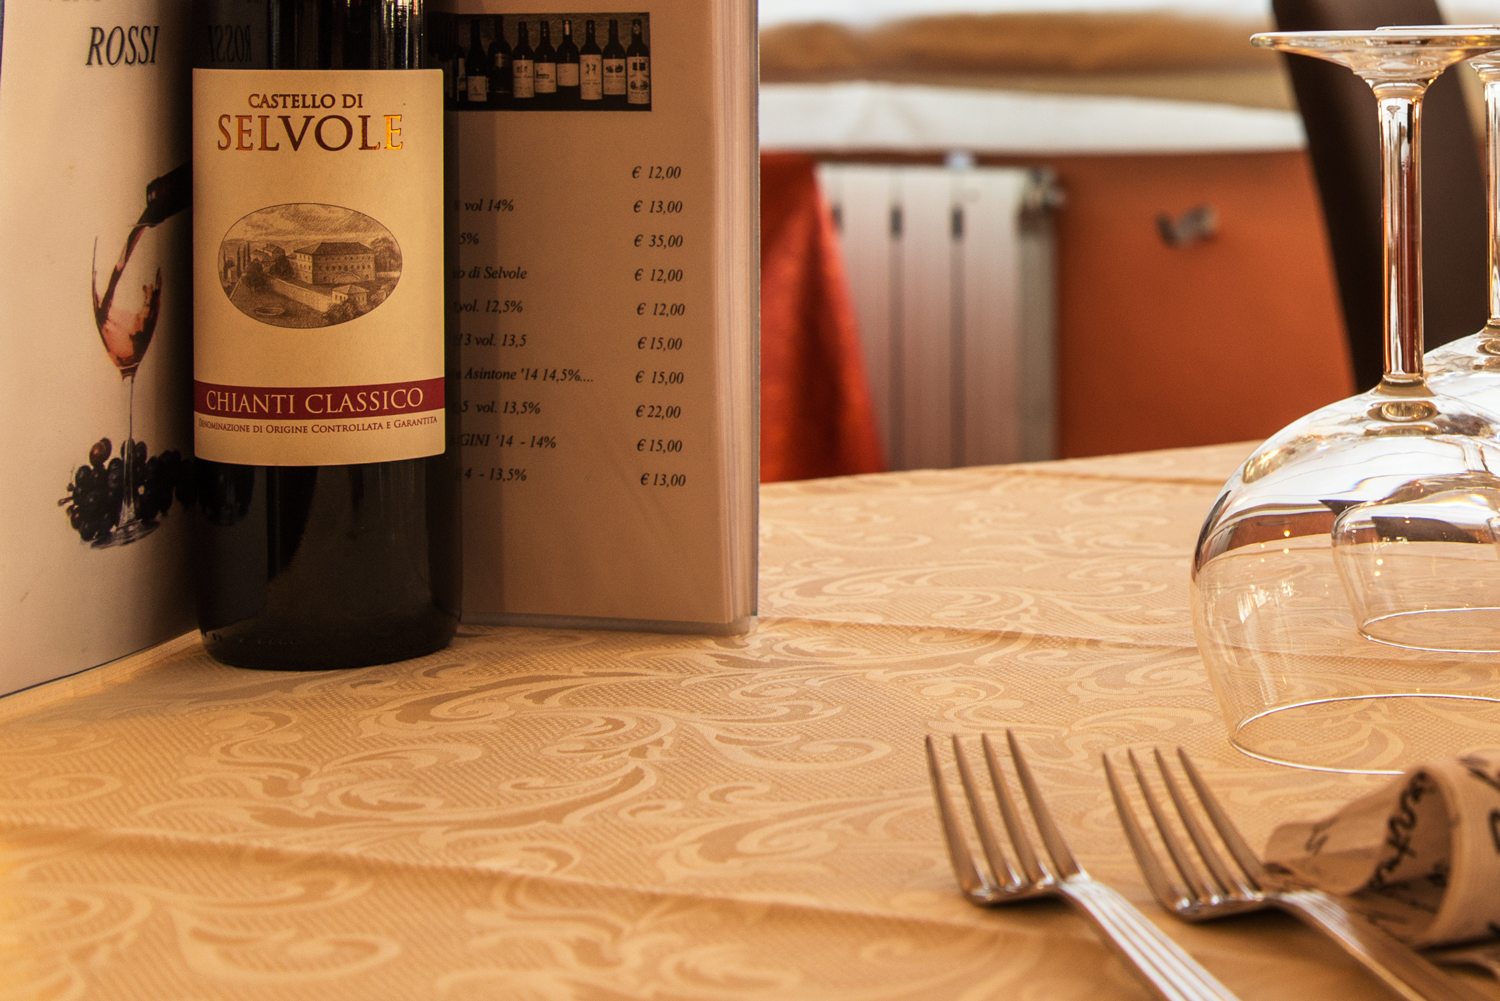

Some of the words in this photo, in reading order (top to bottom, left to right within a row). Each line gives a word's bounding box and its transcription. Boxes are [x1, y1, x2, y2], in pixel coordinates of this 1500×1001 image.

[86, 25, 160, 66] ROSSI
[248, 93, 336, 109] CASTELLO
[341, 93, 364, 109] DI
[217, 114, 403, 152] SELVOLE
[648, 166, 681, 181] 12,00
[465, 199, 483, 212] vol
[487, 199, 514, 212] 14%
[649, 200, 683, 215] 13,00
[459, 233, 480, 246] 5%
[648, 234, 683, 249] 35,00
[468, 266, 480, 279] di
[484, 266, 527, 280] Selvole
[650, 268, 683, 283] 12,00
[485, 300, 523, 315] 12,5%
[652, 302, 685, 317] 12,00
[475, 334, 496, 347] vol.
[501, 334, 527, 348] 13,5
[650, 336, 682, 352] 15,00
[464, 368, 517, 381] Asintone
[651, 370, 684, 385] 15,00
[206, 389, 295, 414] CHIANTI
[304, 387, 424, 414] CLASSICO
[476, 401, 498, 414] vol.
[502, 401, 541, 415] 13,5%
[647, 405, 681, 420] 22,00
[198, 418, 250, 433] DENOMINAZIONE
[253, 423, 263, 433] DI
[266, 423, 308, 434] ORIGINE
[311, 422, 383, 434] CONTROLLATA
[386, 421, 391, 429] E
[393, 416, 438, 429] GARANTITA
[460, 435, 490, 448] GINI
[530, 435, 557, 449] 14%
[649, 439, 682, 453] 15,00
[489, 468, 527, 483] 13,5%
[652, 473, 686, 488] 13,00
